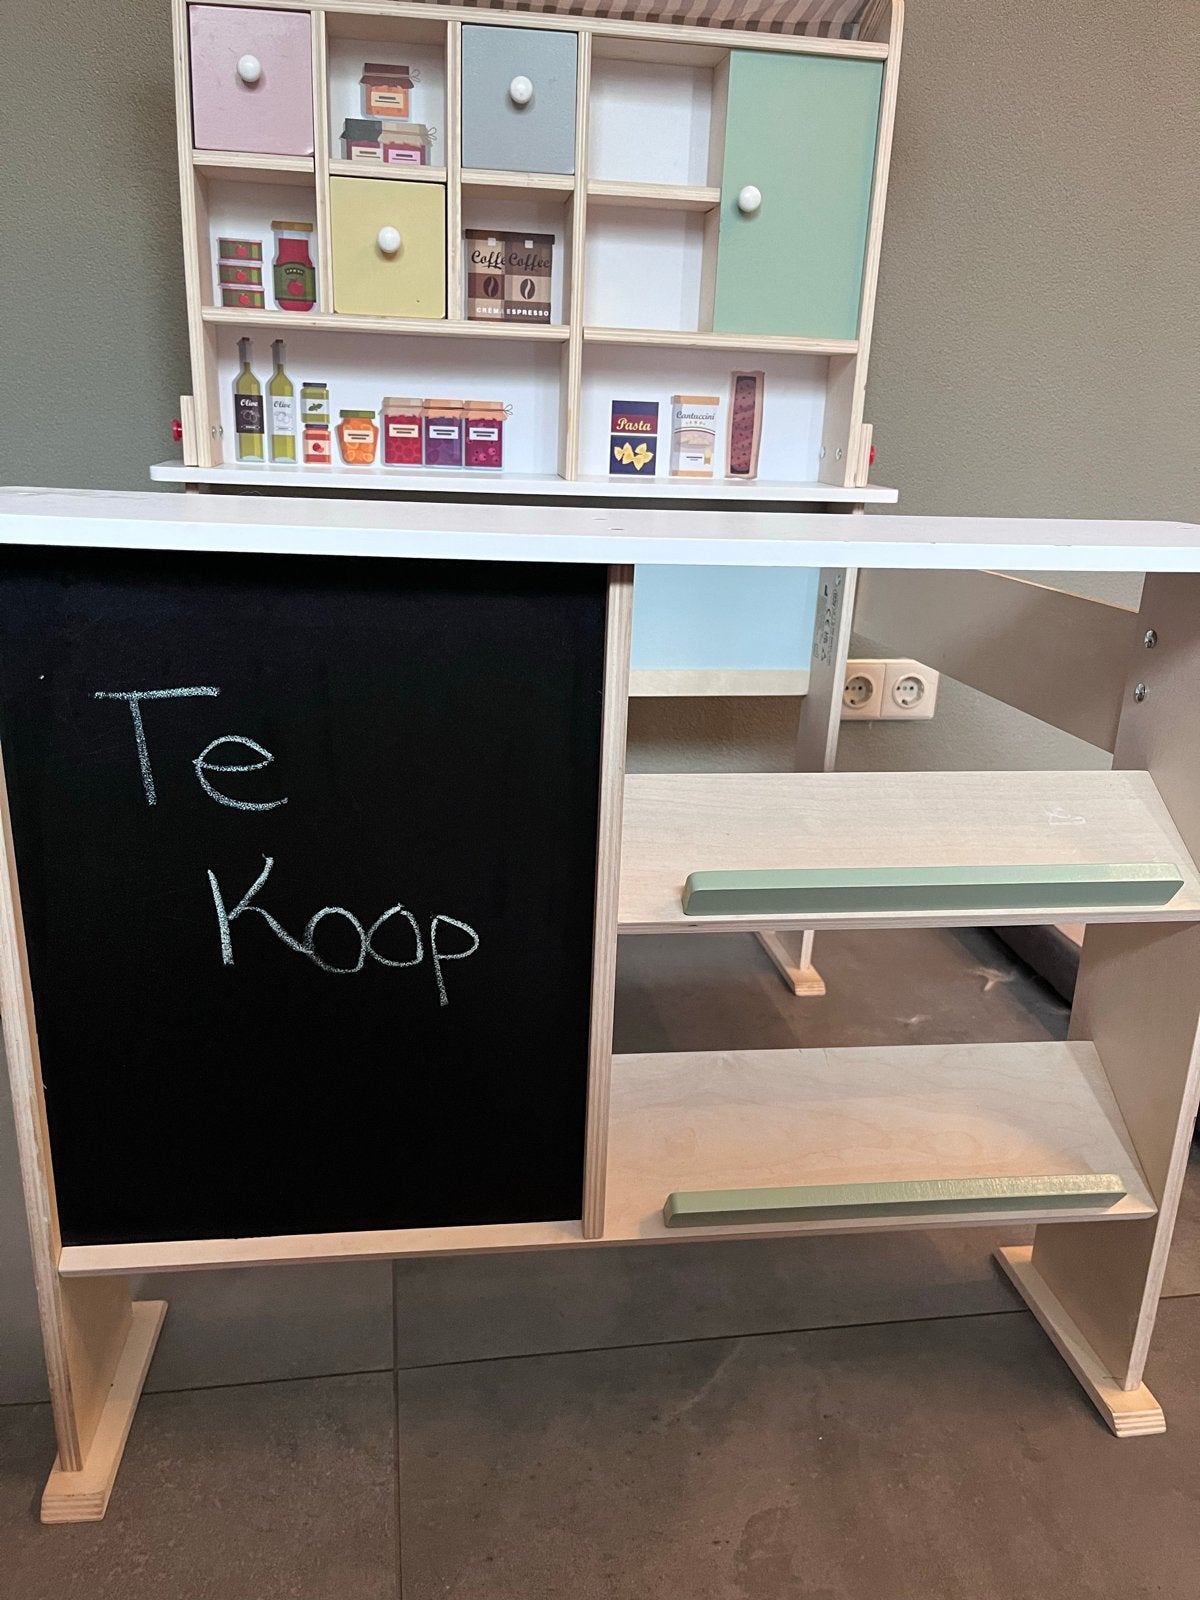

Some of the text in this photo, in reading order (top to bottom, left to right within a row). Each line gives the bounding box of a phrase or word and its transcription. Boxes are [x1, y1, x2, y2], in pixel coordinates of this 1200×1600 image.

[508, 252, 551, 271] Coffee
[506, 308, 549, 316] ESPRESSO
[240, 398, 258, 407] Olive
[273, 400, 291, 408] Olive
[676, 410, 716, 421] Cantuccini
[616, 417, 652, 431] Pasta
[93, 686, 289, 811] Te
[208, 854, 480, 1006] Koop
